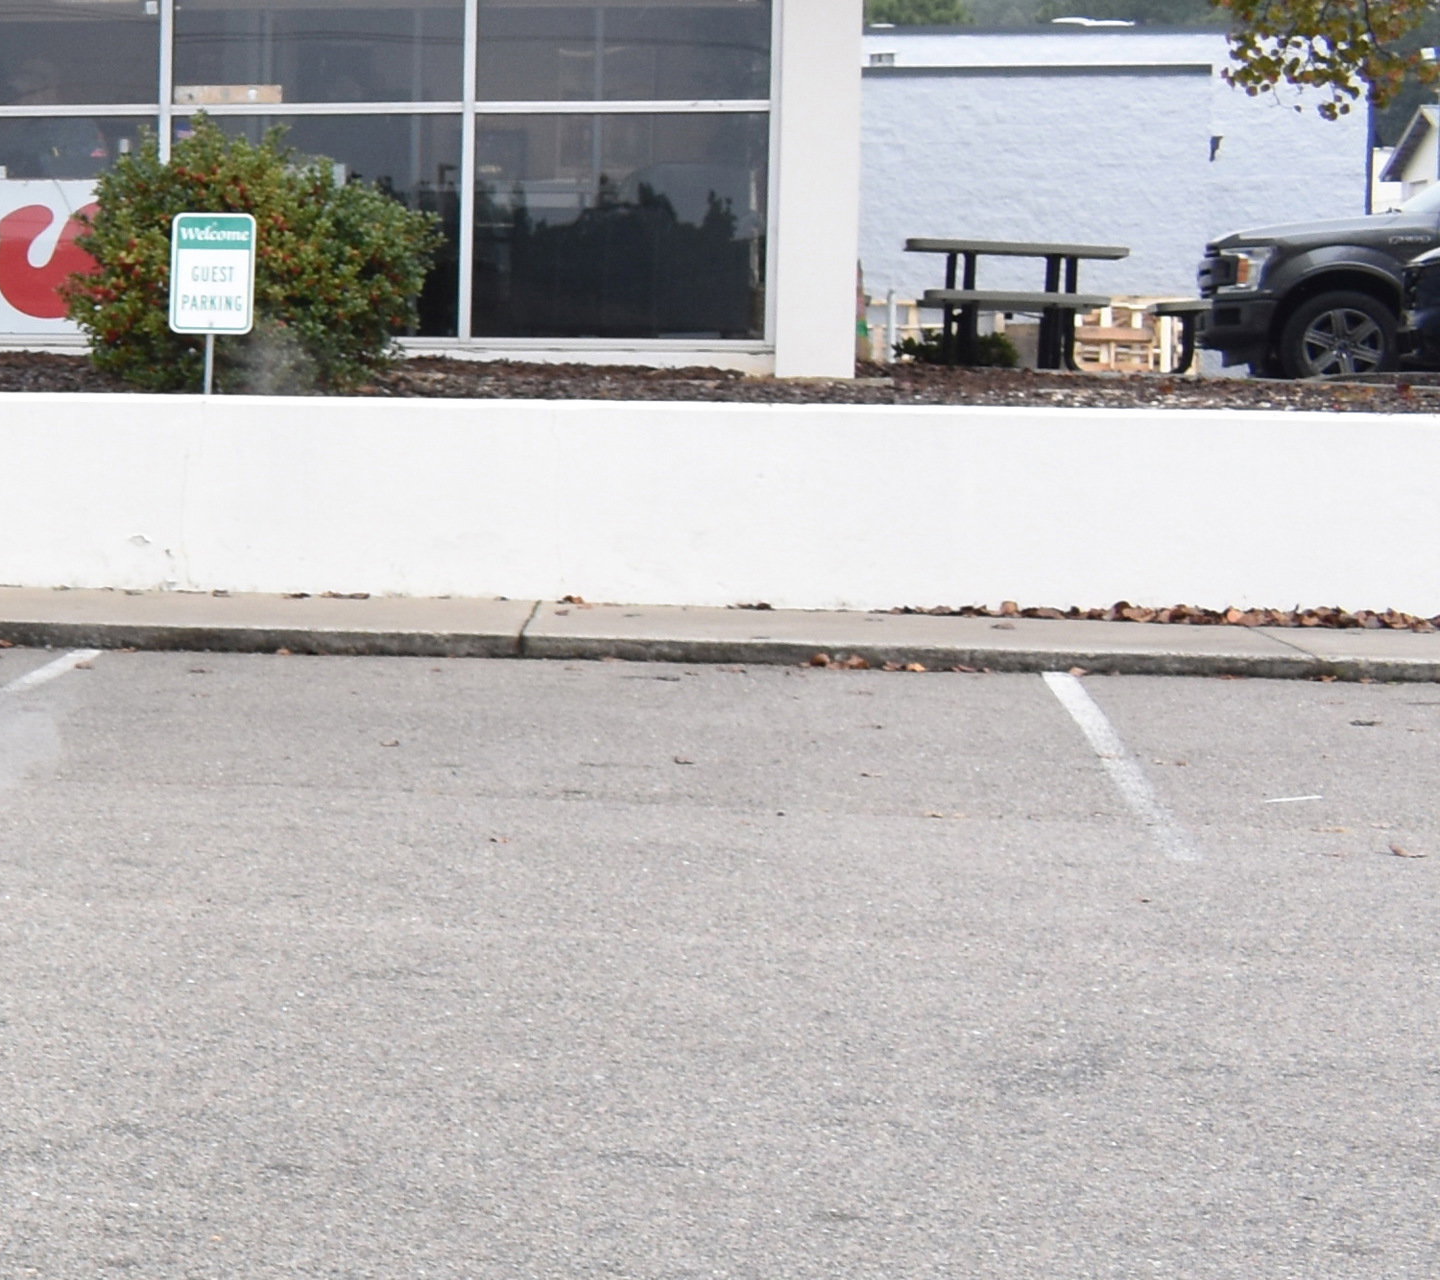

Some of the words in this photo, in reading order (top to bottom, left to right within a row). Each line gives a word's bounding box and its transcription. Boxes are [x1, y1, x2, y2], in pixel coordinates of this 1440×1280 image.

[180, 221, 250, 241] Welcome
[191, 266, 235, 282] GUEST
[181, 294, 243, 311] PARKING
